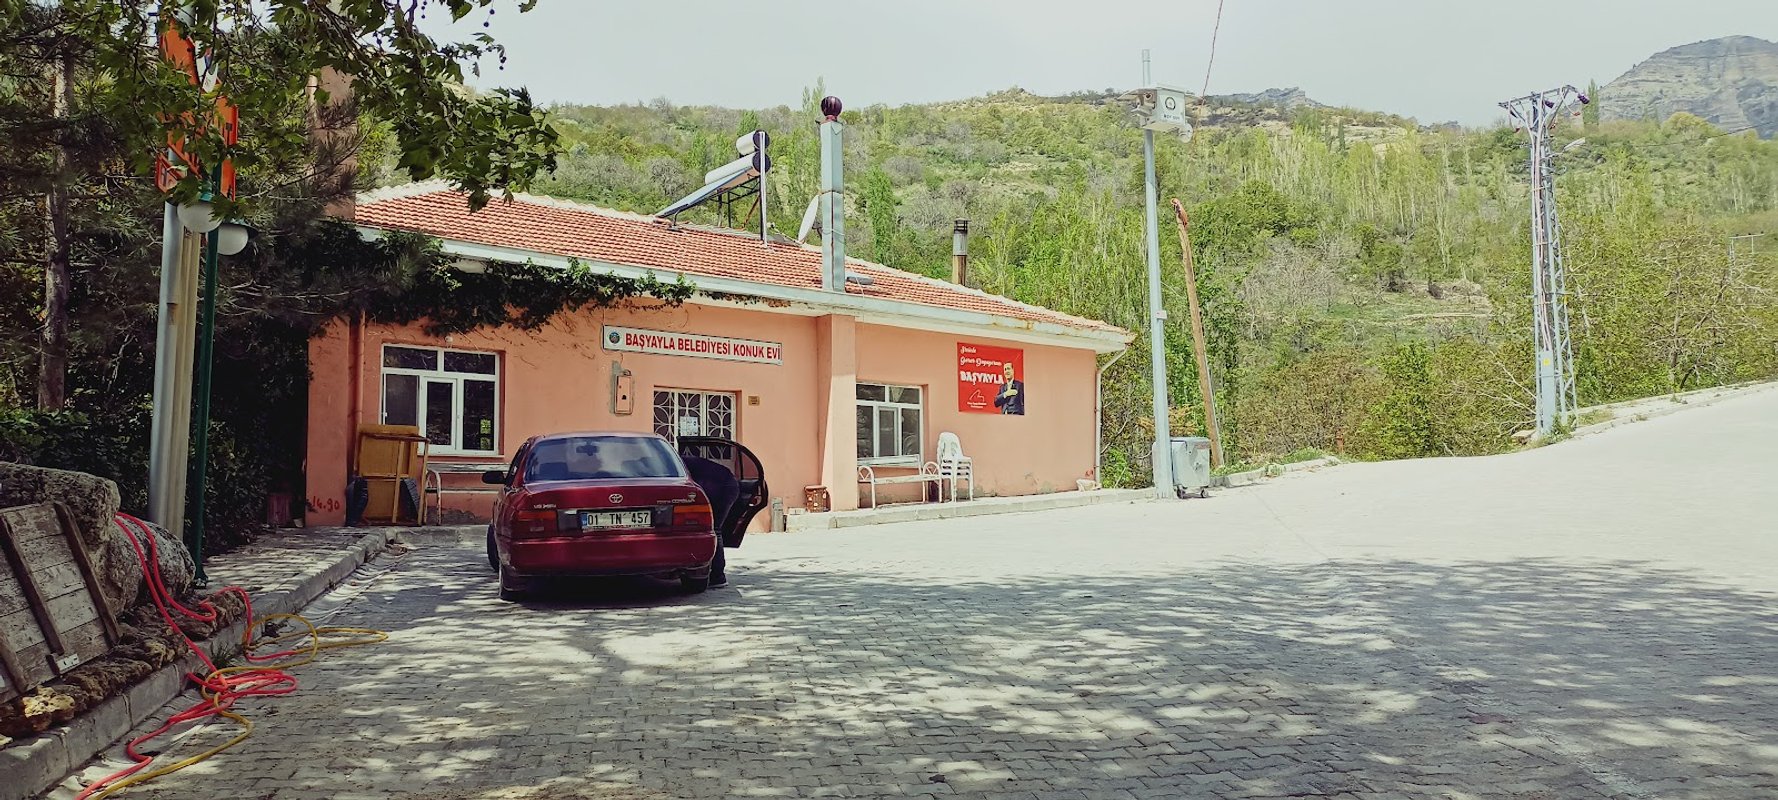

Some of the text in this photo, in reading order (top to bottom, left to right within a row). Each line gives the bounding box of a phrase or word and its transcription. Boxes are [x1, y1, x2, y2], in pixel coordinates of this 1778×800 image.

[625, 333, 781, 360] BAŞYAYLA BELEDİYESİ KONUK EVİ
[960, 371, 1005, 385] BAŞYAYLA
[587, 512, 649, 526] 01 TN 457
